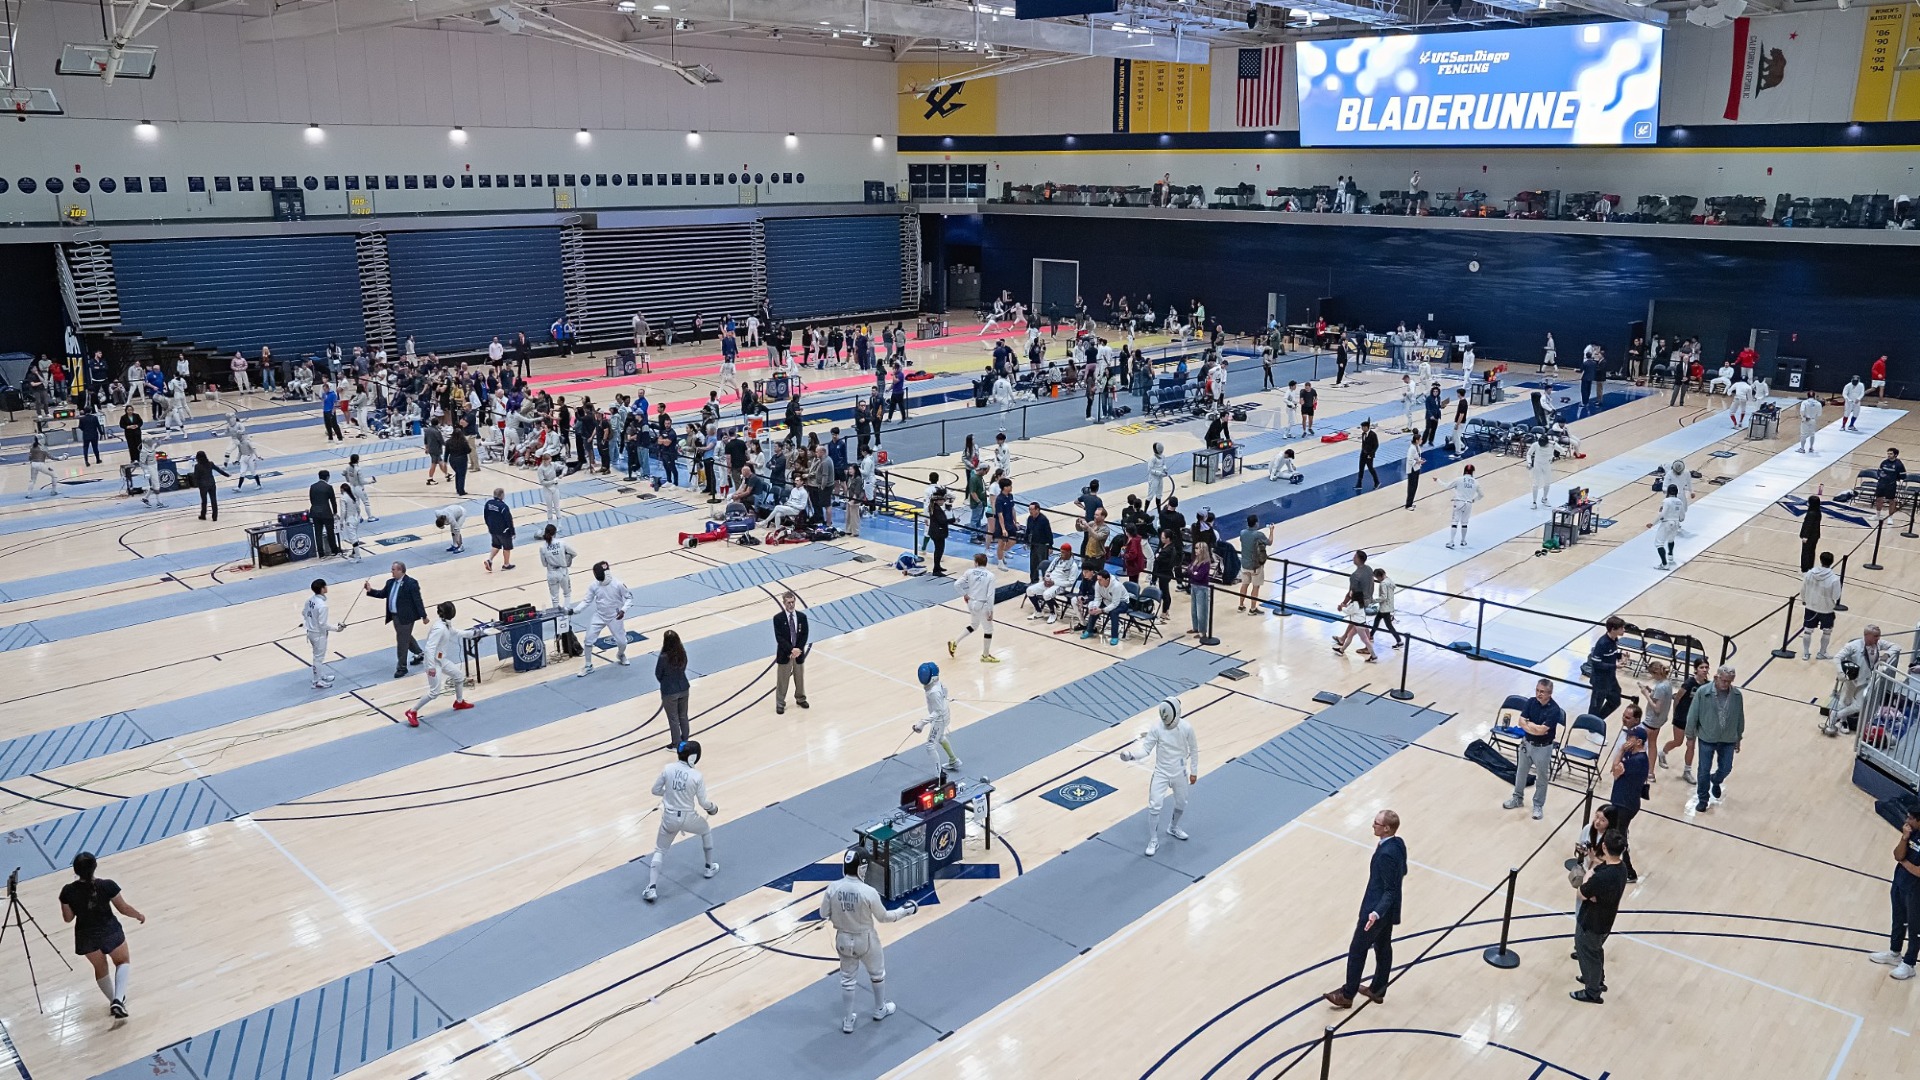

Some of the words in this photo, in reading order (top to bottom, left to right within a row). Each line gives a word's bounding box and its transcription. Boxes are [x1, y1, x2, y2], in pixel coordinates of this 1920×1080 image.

[1746, 35, 1757, 69] CALIFORNIA
[1437, 63, 1490, 75] FENCING
[1743, 71, 1753, 99] REPUBLIC
[70, 209, 87, 217] 109
[1373, 336, 1387, 344] THE
[1370, 348, 1389, 356] WEST
[675, 769, 689, 782] YAO
[672, 780, 687, 791] USA
[977, 806, 985, 814] C1
[837, 890, 859, 903] SMITH
[841, 903, 855, 913] USA
